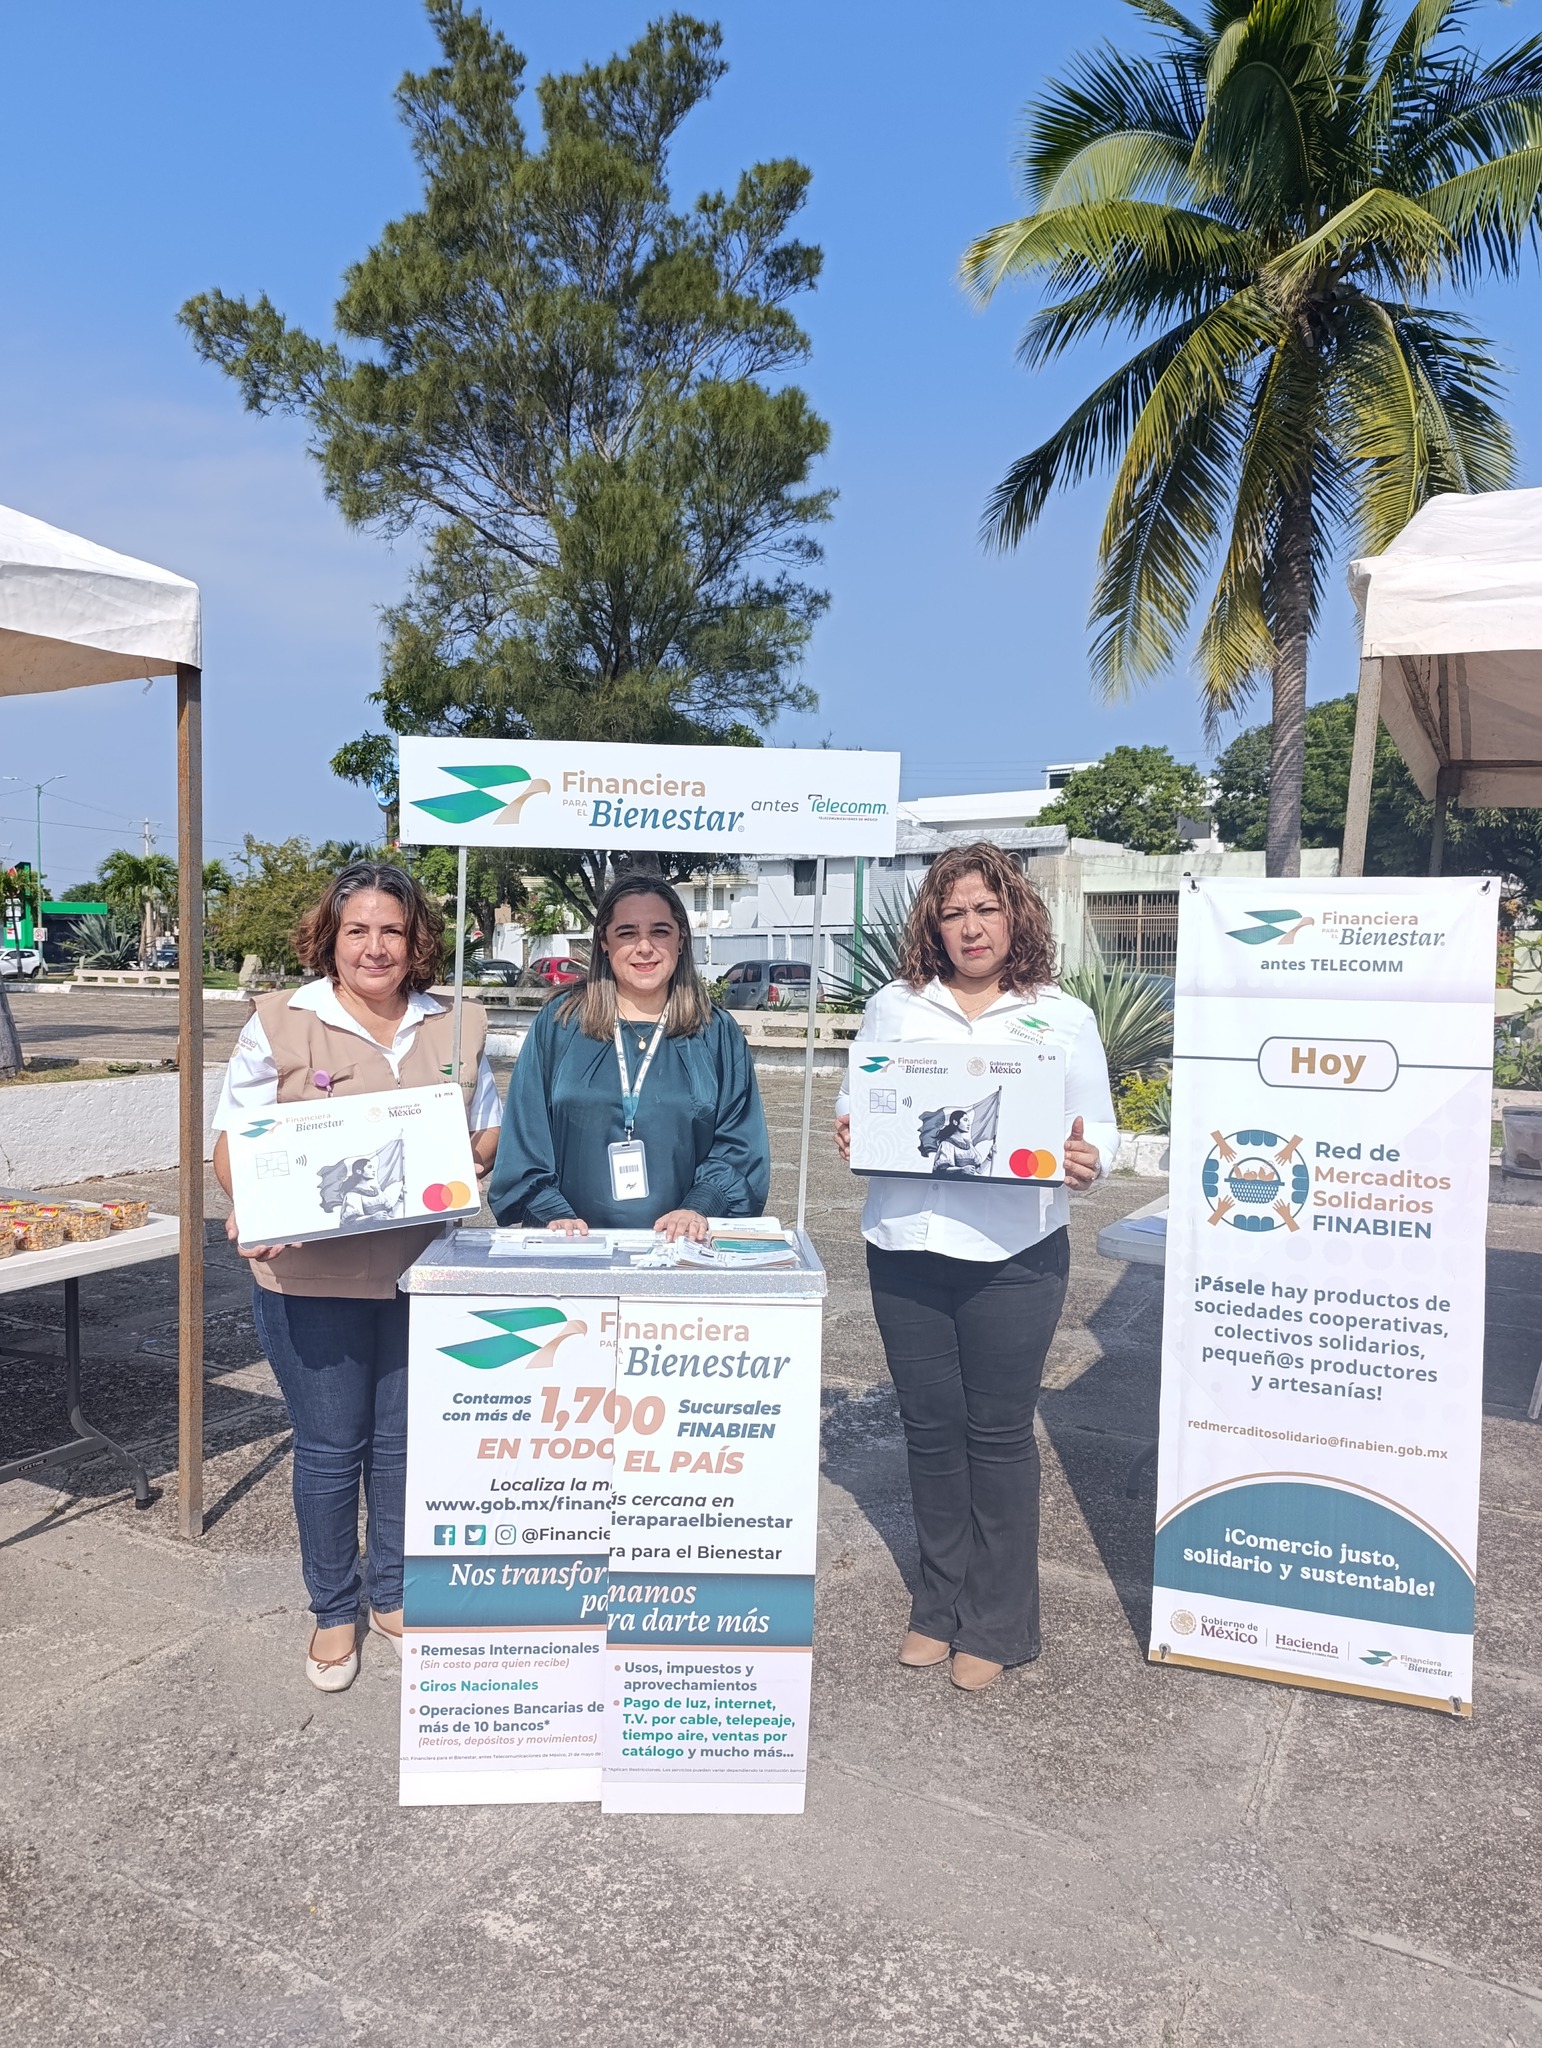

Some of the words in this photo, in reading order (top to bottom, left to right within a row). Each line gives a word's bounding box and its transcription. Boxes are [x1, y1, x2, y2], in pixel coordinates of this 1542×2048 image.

[562, 770, 706, 797] Financiera
[562, 799, 588, 807] PARA
[589, 798, 745, 833] Bienestar
[751, 800, 799, 813] antes
[1321, 911, 1419, 926] Financiera
[1339, 927, 1445, 947] Bienestar
[1260, 958, 1306, 971] antes
[1310, 958, 1404, 973] TELECOMM
[897, 1057, 938, 1065] Financiera
[989, 1065, 1022, 1075] México
[1290, 1046, 1367, 1085] Hoy
[285, 1113, 332, 1124] Financiera
[388, 1107, 422, 1118] México
[295, 1119, 344, 1133] Bienestar
[1314, 1141, 1362, 1161] Red
[1369, 1143, 1400, 1162] de
[1314, 1165, 1451, 1191] Mercaditos
[1312, 1191, 1434, 1215] Solidarios
[1312, 1214, 1432, 1239] FINABIEN
[1194, 1275, 1265, 1295] ¡Pásele
[1271, 1281, 1308, 1303] hay
[1313, 1287, 1419, 1310] productos
[1425, 1295, 1451, 1312] de
[1194, 1298, 1303, 1323] sociedades
[1309, 1308, 1449, 1338] cooperativas,
[1213, 1322, 1313, 1347] colectivos
[1318, 1332, 1426, 1360] solidarios,
[624, 1343, 791, 1379] Bienestar
[1201, 1343, 1304, 1369] pequeñ@s
[1310, 1356, 1438, 1383] productores
[1250, 1374, 1263, 1391] y
[1268, 1374, 1382, 1401] artesanías!
[452, 1392, 532, 1405] Contamos
[678, 1398, 781, 1416] Sucursales
[442, 1410, 471, 1422] con
[475, 1408, 508, 1422] más
[512, 1409, 532, 1421] de
[677, 1422, 776, 1439] FINABIEN
[1188, 1417, 1448, 1459] redmercaditosolidario@finabien.gob.mx
[477, 1438, 522, 1459] EN
[623, 1450, 661, 1473] EL
[669, 1445, 745, 1474] PAÍS
[490, 1477, 566, 1492] Localiza
[570, 1477, 588, 1492] la
[631, 1494, 707, 1507] cercana
[711, 1496, 734, 1508] en
[631, 1546, 671, 1560] para
[676, 1544, 692, 1559] el
[697, 1545, 783, 1560] Bienestar
[1224, 1527, 1333, 1559] ¡Comercio
[1339, 1541, 1400, 1571] justo,
[448, 1563, 496, 1586] Nos
[1183, 1547, 1273, 1574] solidario
[1280, 1562, 1293, 1580] y
[1300, 1564, 1436, 1597] sustentable!
[641, 1607, 711, 1633] darte
[716, 1607, 770, 1633] más
[1200, 1615, 1245, 1629] Gobierno
[1247, 1622, 1259, 1632] de
[1200, 1623, 1258, 1645] México
[1275, 1633, 1339, 1654] Hacienda
[420, 1644, 486, 1657] Remesas
[489, 1642, 600, 1656] Internacionales
[420, 1659, 440, 1670] (Sin
[442, 1660, 472, 1669] costo
[473, 1660, 499, 1671] para
[501, 1659, 531, 1670] quien
[533, 1658, 570, 1669] recibe)
[624, 1662, 662, 1675] Usos,
[666, 1661, 742, 1676] impuestos
[745, 1665, 754, 1677] y
[1400, 1654, 1442, 1667] Financiera
[419, 1680, 457, 1692] Giros
[460, 1679, 539, 1691] Nacionales
[624, 1679, 758, 1692] aprovechamientos
[419, 1703, 510, 1718] Operaciones
[513, 1702, 584, 1715] Bancarias
[587, 1701, 605, 1713] de
[623, 1697, 660, 1710] Pago
[664, 1697, 682, 1709] de
[686, 1697, 711, 1710] luz,
[714, 1697, 776, 1711] internet,
[418, 1721, 449, 1733] más
[452, 1721, 471, 1733] de
[474, 1721, 489, 1732] 10
[622, 1713, 648, 1725] T.V.
[651, 1716, 676, 1727] por
[679, 1714, 722, 1726] cable,
[725, 1714, 796, 1728] telepeaje,
[418, 1737, 461, 1748] (Retiros,
[464, 1735, 515, 1747] depósitos
[516, 1738, 524, 1746] y
[526, 1734, 598, 1745] movimientos)
[622, 1729, 673, 1743] tiempo
[677, 1729, 708, 1742] aire,
[712, 1731, 759, 1742] ventas
[763, 1732, 788, 1744] por
[622, 1745, 684, 1759] catálogo
[687, 1748, 697, 1759] y
[700, 1746, 750, 1758] mucho
[753, 1746, 794, 1758] más...
